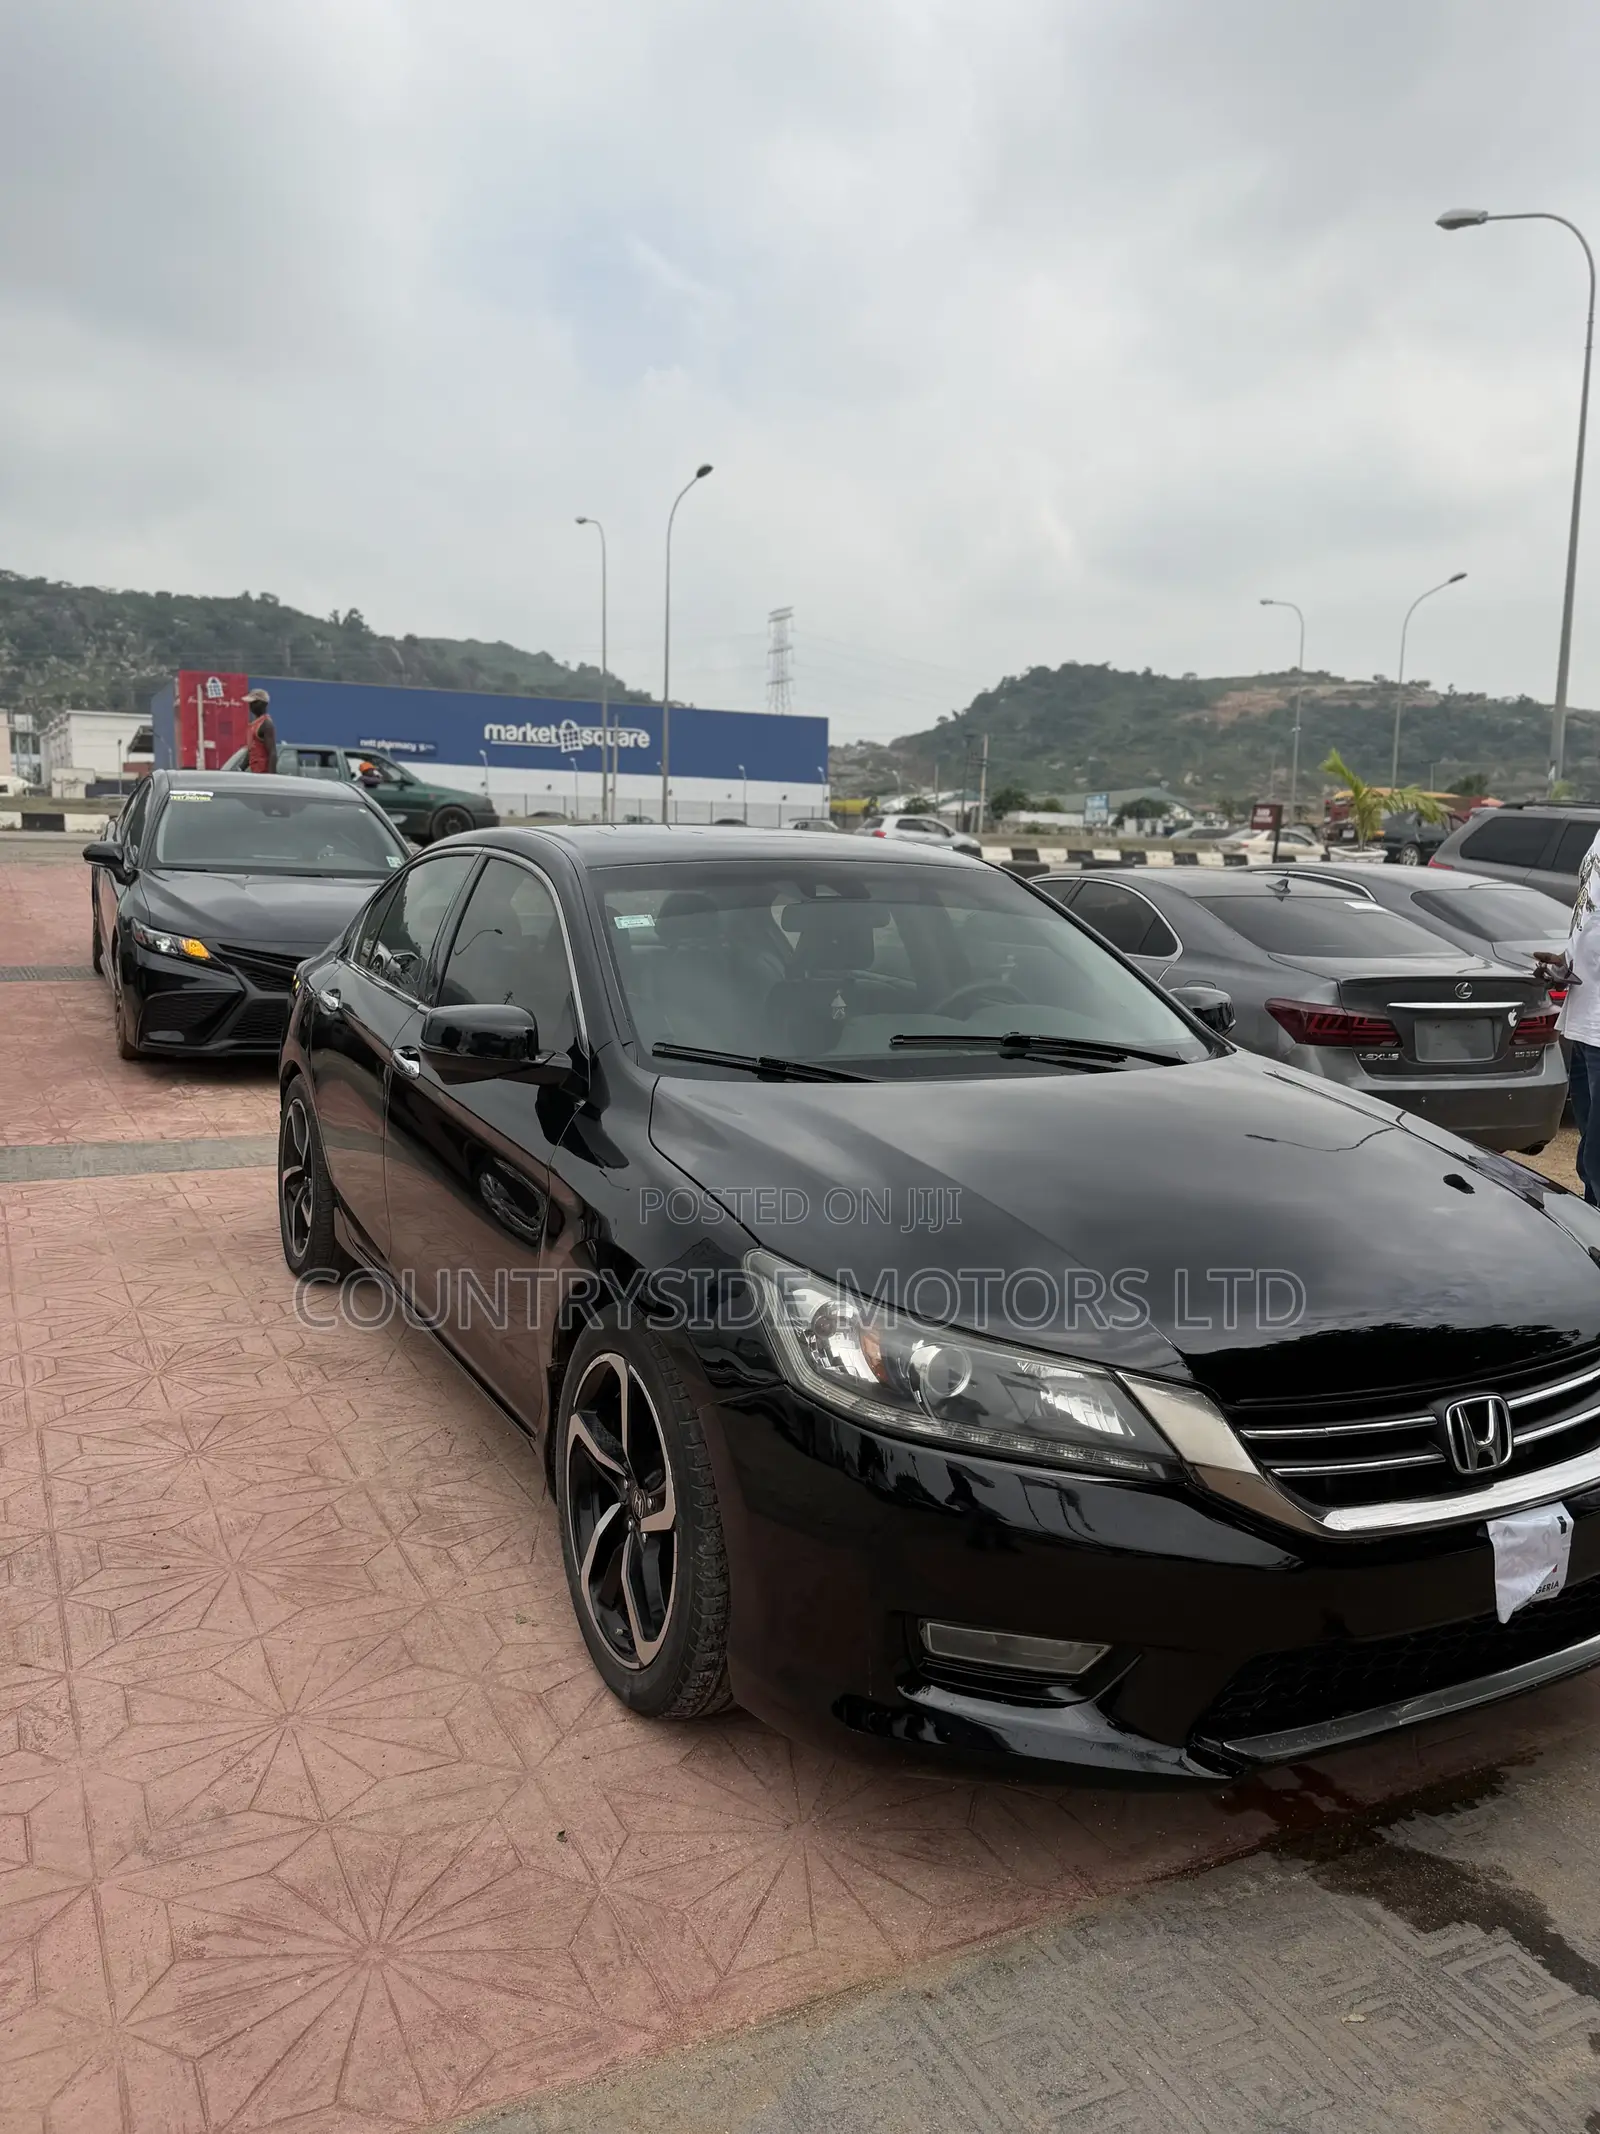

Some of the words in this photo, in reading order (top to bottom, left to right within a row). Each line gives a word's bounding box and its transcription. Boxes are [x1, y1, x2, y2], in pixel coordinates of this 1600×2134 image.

[484, 723, 558, 744] market
[582, 727, 650, 748] square
[1359, 1053, 1399, 1061] LEXUS
